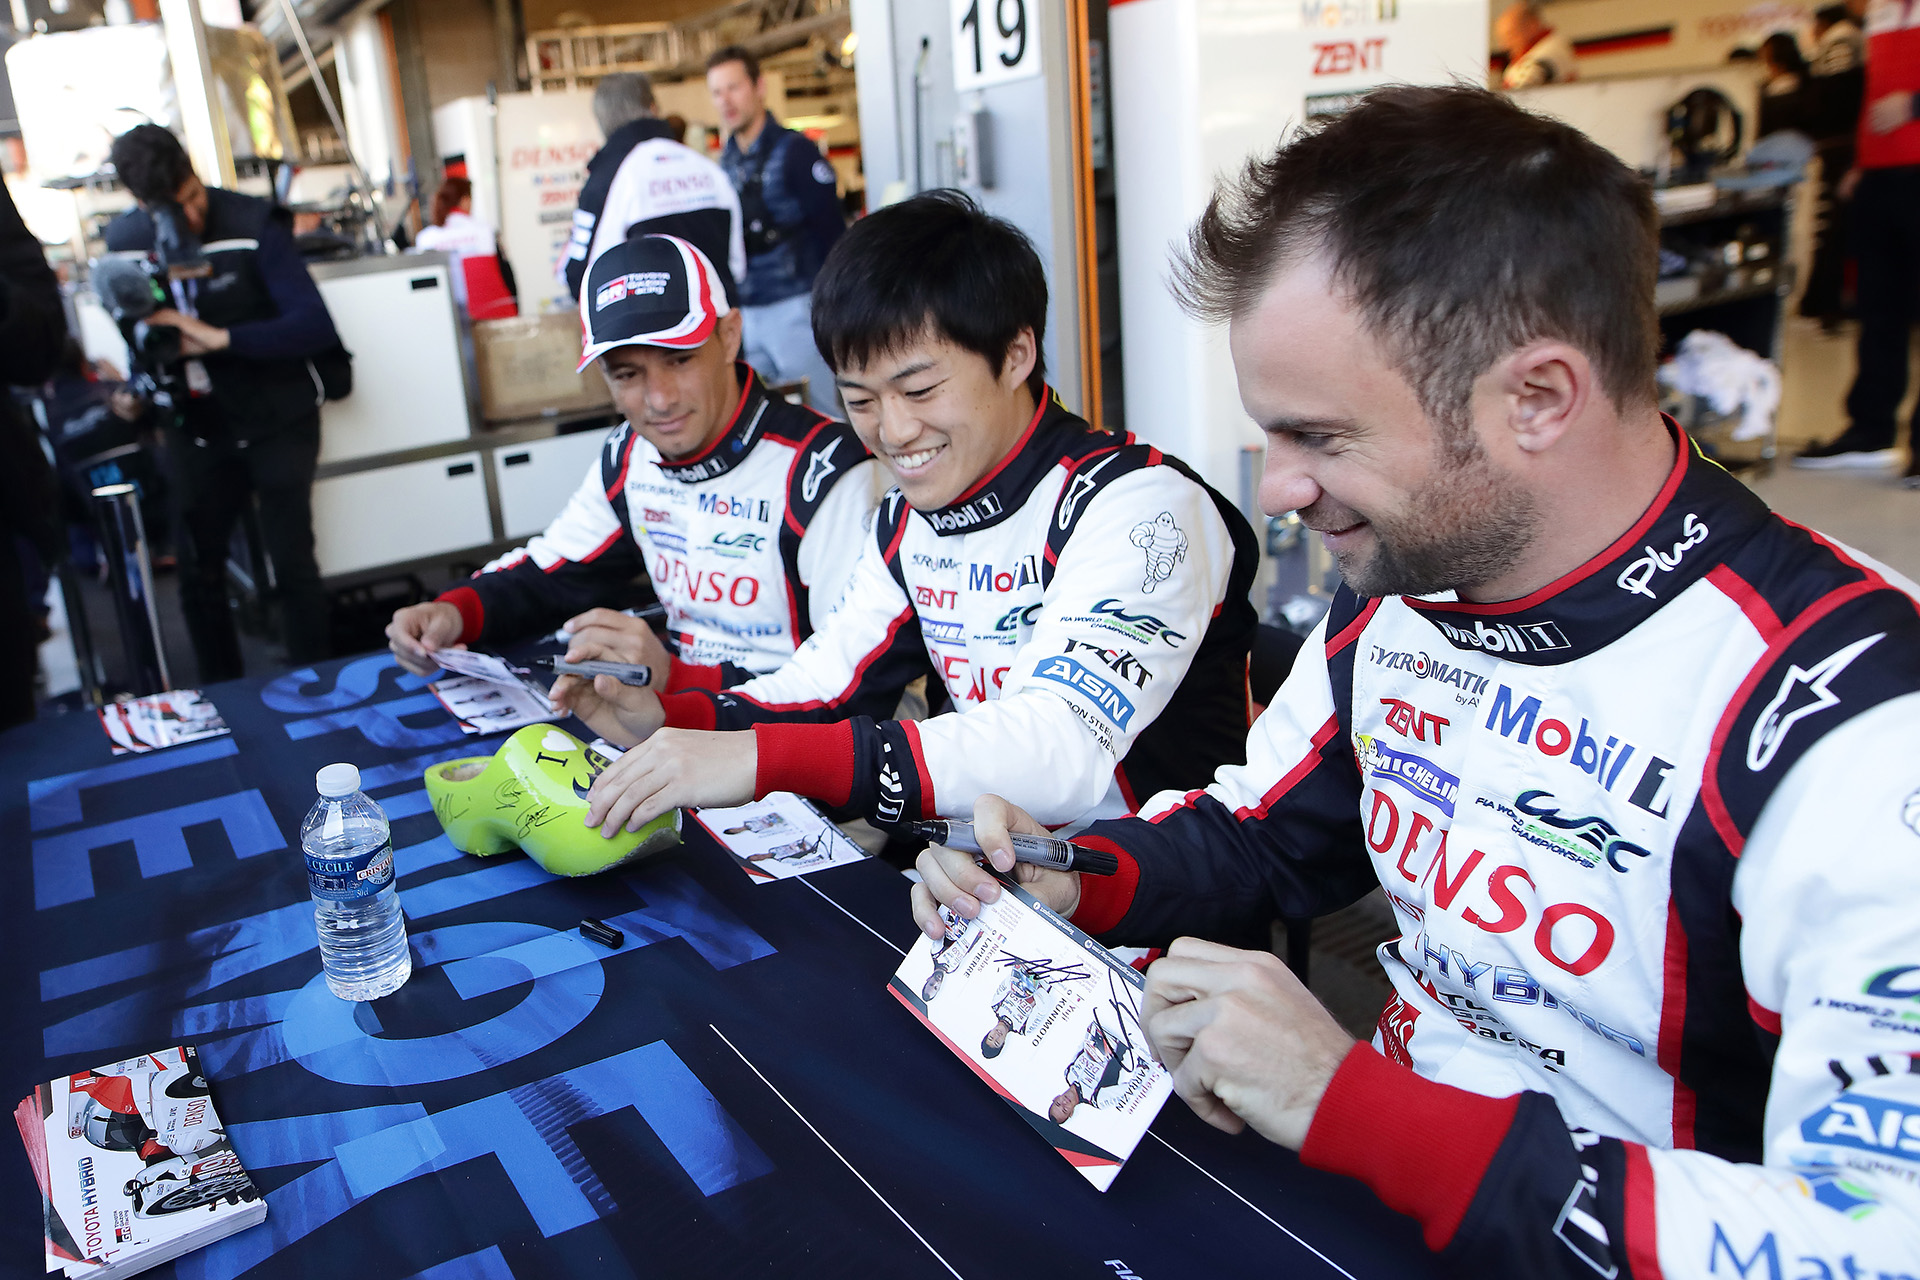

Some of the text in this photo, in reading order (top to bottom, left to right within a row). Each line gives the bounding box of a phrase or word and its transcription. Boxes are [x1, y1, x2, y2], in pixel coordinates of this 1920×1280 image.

[961, 0, 1026, 74] 19
[1311, 38, 1387, 74] ZENT
[699, 493, 752, 519] Mobil
[929, 503, 981, 532] Mobil
[968, 561, 1026, 593] Moil
[1616, 513, 1709, 600] Plus
[916, 586, 958, 609] ZENT
[1090, 598, 1187, 648] WEC
[1090, 622, 1149, 645] CHAMPIONSHIP
[1104, 618, 1152, 642] ENDURANCE
[1436, 619, 1527, 652] Mobil
[1042, 660, 1128, 722] AISIN
[1455, 693, 1467, 706] by
[1380, 698, 1450, 746] ZENT
[535, 752, 568, 767] I
[1485, 684, 1675, 819] Mobil 1
[1375, 753, 1459, 805] MICHELIN
[1475, 797, 1602, 863] FIA WOLD ENDURANCE
[1511, 824, 1596, 869] CHAMPIONSHIP
[1514, 789, 1651, 873] WEC
[1368, 788, 1615, 977] DENSO
[963, 937, 993, 979] LAPIERRE
[977, 943, 999, 972] Nicolas
[1031, 997, 1067, 1047] KUNIMOTO
[1061, 1004, 1076, 1022] Yuji
[183, 1099, 207, 1127] DENSO
[78, 1156, 102, 1255] TOYOTA HYBRID
